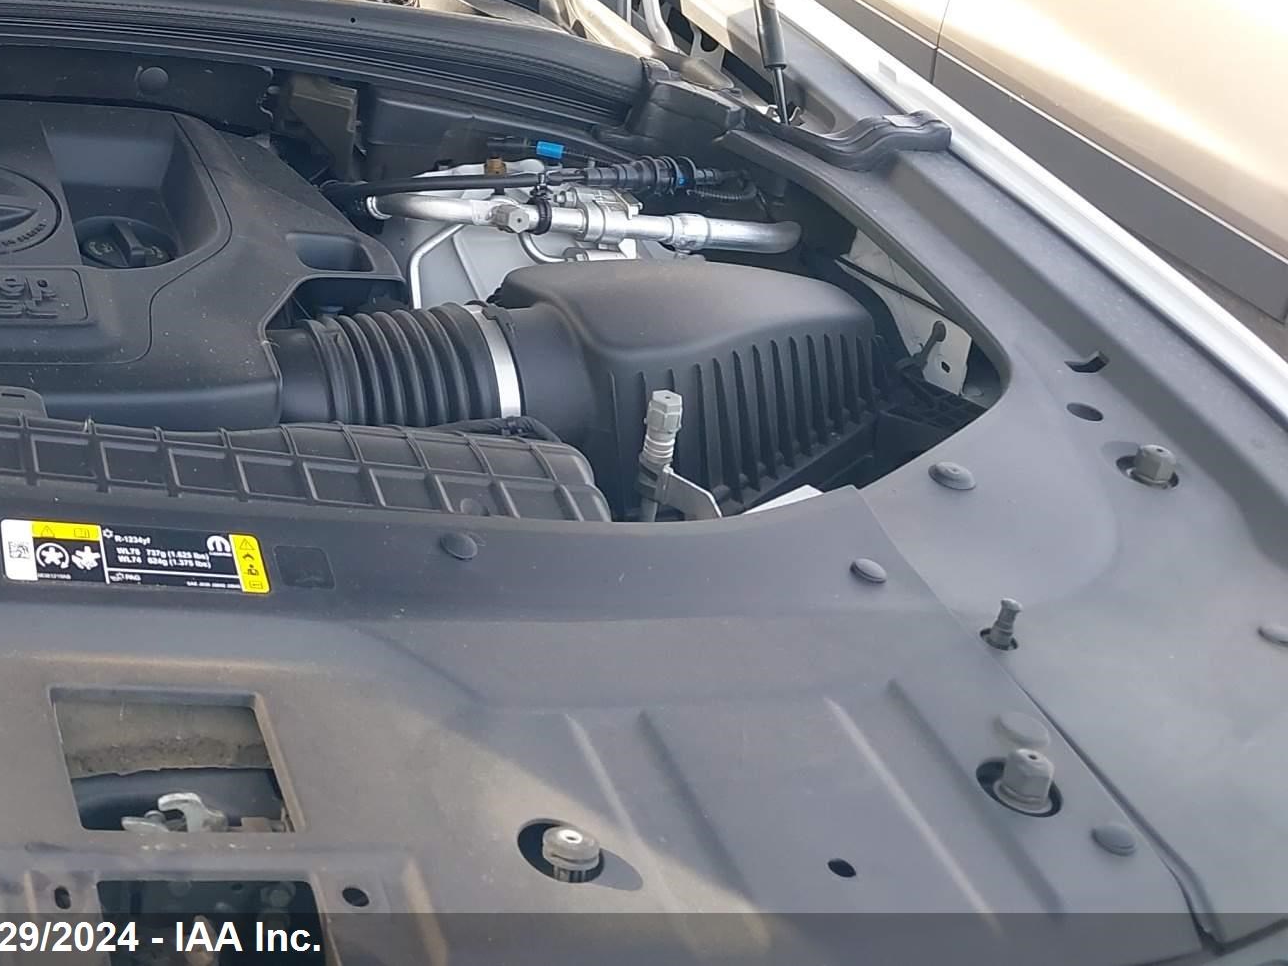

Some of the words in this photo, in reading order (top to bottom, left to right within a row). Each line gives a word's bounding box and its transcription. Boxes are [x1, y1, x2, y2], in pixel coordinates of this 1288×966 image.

[114, 534, 151, 546] R-1234yf
[146, 548, 167, 559] 737g
[192, 552, 210, 562] lbs)
[194, 560, 212, 569] lbs)
